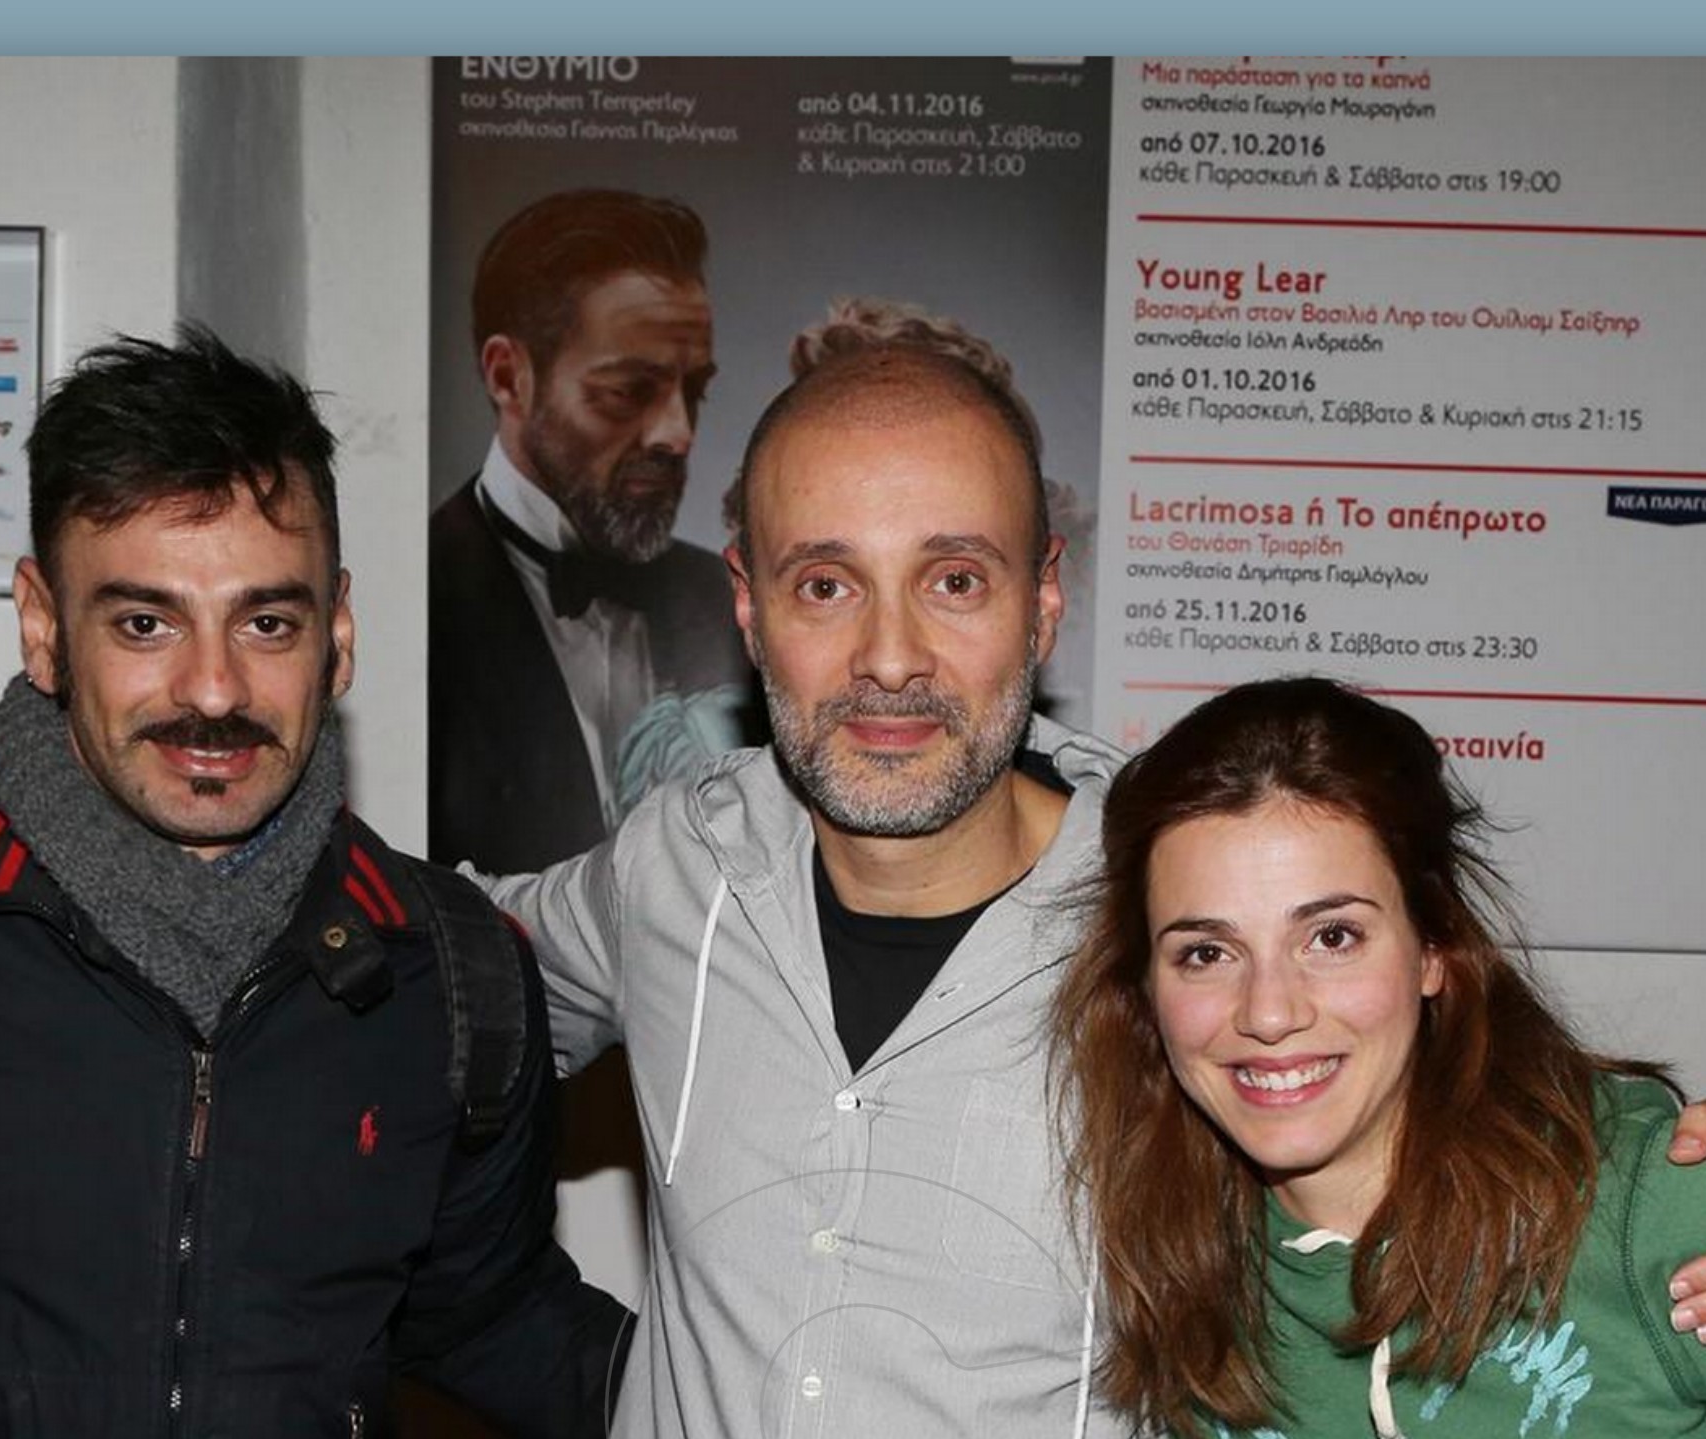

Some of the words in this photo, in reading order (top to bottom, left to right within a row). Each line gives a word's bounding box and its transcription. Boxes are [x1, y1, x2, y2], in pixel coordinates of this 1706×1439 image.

[1141, 63, 1181, 84] Μια
[1186, 65, 1300, 89] παράσταση
[1305, 71, 1336, 91] για
[1342, 71, 1365, 89] τα
[1370, 69, 1431, 90] καπνά
[798, 92, 842, 114] από
[847, 92, 983, 117] 04.11.2016
[1141, 92, 1249, 113] σκηνοθεσία
[797, 121, 847, 143] κάθε
[853, 121, 982, 150] Παρασκευή,
[987, 124, 1082, 151] Σάββατο
[1140, 131, 1183, 153] από
[1189, 131, 1325, 157] 07.10.2016
[797, 151, 814, 173] &
[822, 151, 905, 178] Κυριακή
[958, 152, 1025, 176] 21:00
[1139, 160, 1189, 184] κάθε
[1195, 160, 1317, 190] Παρασκευή
[1324, 164, 1340, 187] &
[1348, 164, 1441, 191] Σάββατο
[1498, 169, 1561, 193] 19:00
[1136, 259, 1244, 301] Young
[1257, 262, 1326, 293] Lear
[1134, 297, 1240, 324] βασισμένη
[1245, 306, 1295, 322] στον
[1301, 301, 1378, 325] Βασιλιά
[1383, 304, 1425, 330] Ληρ
[1430, 310, 1466, 328] του
[1471, 306, 1553, 334] Ουίλιαμ
[1559, 309, 1640, 338] Σαίξπηρ
[1134, 328, 1241, 349] σκηνοθεσία
[1132, 367, 1175, 388] από
[1181, 367, 1315, 392] 01.10.2016
[1131, 395, 1181, 418] κάθε
[1187, 395, 1314, 424] Παρασκευή,
[1320, 399, 1412, 426] Σάββατο
[1418, 403, 1435, 425] &
[1442, 403, 1525, 431] Κυριακή
[1578, 406, 1642, 432] 21:15
[1614, 494, 1647, 509] ΝΕΑ
[1129, 492, 1293, 525] Lacrimosa
[1306, 496, 1324, 526] ή
[1336, 496, 1374, 528] Το
[1387, 500, 1546, 540] απέπρωτο
[1126, 534, 1162, 551] του
[1166, 530, 1251, 553] Θανάση
[1257, 532, 1343, 560] Τριαρίδη
[1126, 561, 1232, 580] σκηνοθεσία
[1125, 599, 1166, 619] από
[1174, 598, 1306, 623] 25.11.2016
[1124, 625, 1173, 648] κάθε
[1179, 626, 1298, 655] Παρασκευή
[1305, 631, 1322, 653] &
[1329, 631, 1420, 657] Σάββατο
[1472, 635, 1537, 659] 23:30
[1434, 731, 1543, 760] οταινία
